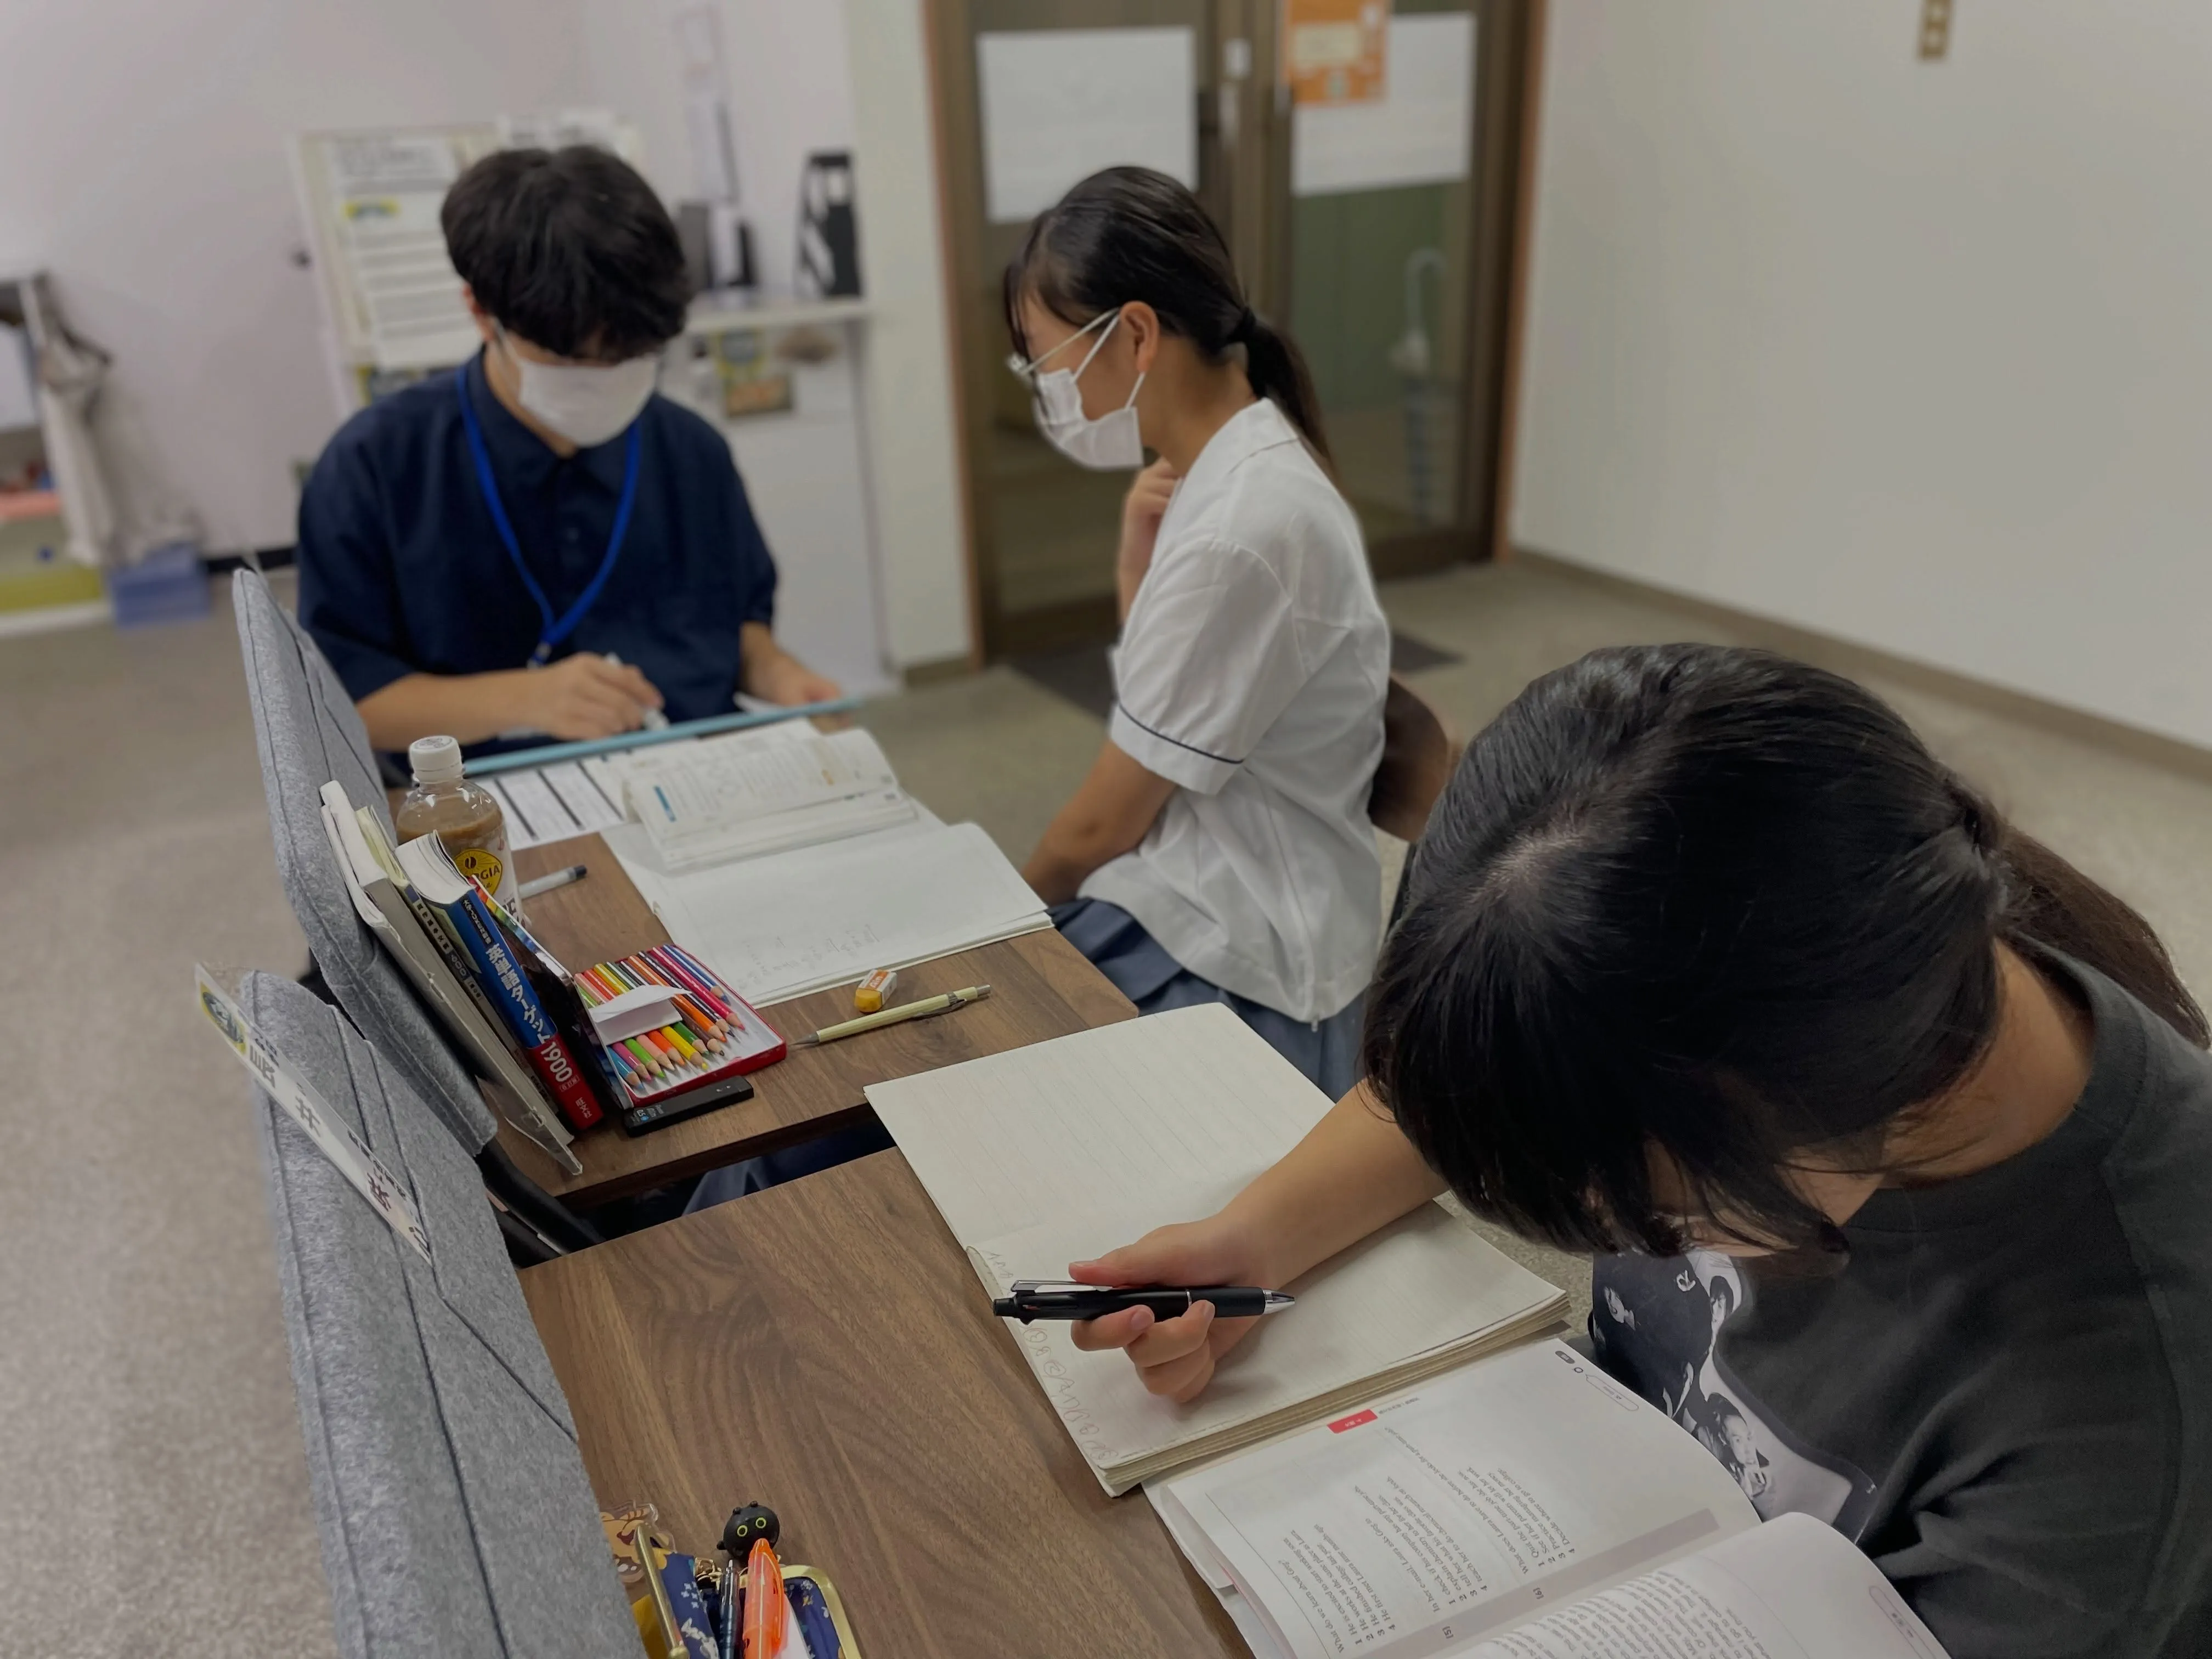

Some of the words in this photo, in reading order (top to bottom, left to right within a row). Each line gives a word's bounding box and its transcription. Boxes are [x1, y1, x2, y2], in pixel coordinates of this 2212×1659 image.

[540, 1041, 572, 1082] 1900
[1520, 1488, 1531, 1498] go
[1505, 1502, 1527, 1523] parents
[1512, 1494, 1538, 1523] managing
[1533, 1502, 1551, 1522] where
[1493, 1504, 1521, 1531] part-time
[1486, 1519, 1504, 1538] Laura
[1523, 1522, 1534, 1534] her
[1548, 1520, 1570, 1547] Decide
[1443, 1534, 1454, 1545] do
[1516, 1530, 1528, 1542] the
[1537, 1521, 1560, 1551] Practice
[1401, 1531, 1424, 1558] company
[1417, 1535, 1443, 1566] chemistry
[1525, 1541, 1541, 1560] Quit
[1537, 1539, 1550, 1555] See
[1293, 1547, 1313, 1571] working
[1308, 1549, 1323, 1564] place
[1326, 1554, 1337, 1566] last
[1392, 1547, 1408, 1566] Laura
[1439, 1544, 1454, 1562] what
[1458, 1550, 1469, 1564] her
[1547, 1555, 1556, 1565] 2
[1557, 1551, 1566, 1560] 3
[1319, 1564, 1333, 1578] same
[1451, 1560, 1463, 1575] her
[1513, 1552, 1529, 1575] What
[1310, 1569, 1324, 1584] start
[1335, 1564, 1353, 1586] college
[1347, 1562, 1364, 1581] Laura
[1440, 1564, 1463, 1592] explain
[1465, 1562, 1483, 1583] teach
[1291, 1574, 1308, 1592] about
[1321, 1582, 1329, 1591] to
[1330, 1577, 1342, 1590] the
[1361, 1579, 1373, 1594] met
[1432, 1573, 1451, 1596] check
[1459, 1573, 1472, 1588] tell
[1480, 1583, 1488, 1593] 4
[1304, 1590, 1319, 1608] learn
[1339, 1588, 1347, 1596] at
[1349, 1585, 1373, 1614] finished
[1422, 1588, 1435, 1603] her
[1458, 1593, 1468, 1602] 2
[1468, 1588, 1479, 1598] 3
[1324, 1589, 1346, 1615] excited
[1342, 1595, 1361, 1618] works
[1370, 1593, 1384, 1609] first
[1429, 1601, 1440, 1613] In
[1316, 1606, 1327, 1618] we
[1342, 1614, 1350, 1623] is
[1368, 1612, 1380, 1626] He
[1379, 1607, 1391, 1622] He
[1322, 1618, 1334, 1631] do
[1346, 1621, 1358, 1636] He
[1357, 1617, 1369, 1631] He
[1387, 1623, 1397, 1632] 4
[1365, 1632, 1374, 1641] 2
[1376, 1628, 1386, 1637] 3
[1330, 1629, 1346, 1654] What
[1354, 1638, 1363, 1646] 1
